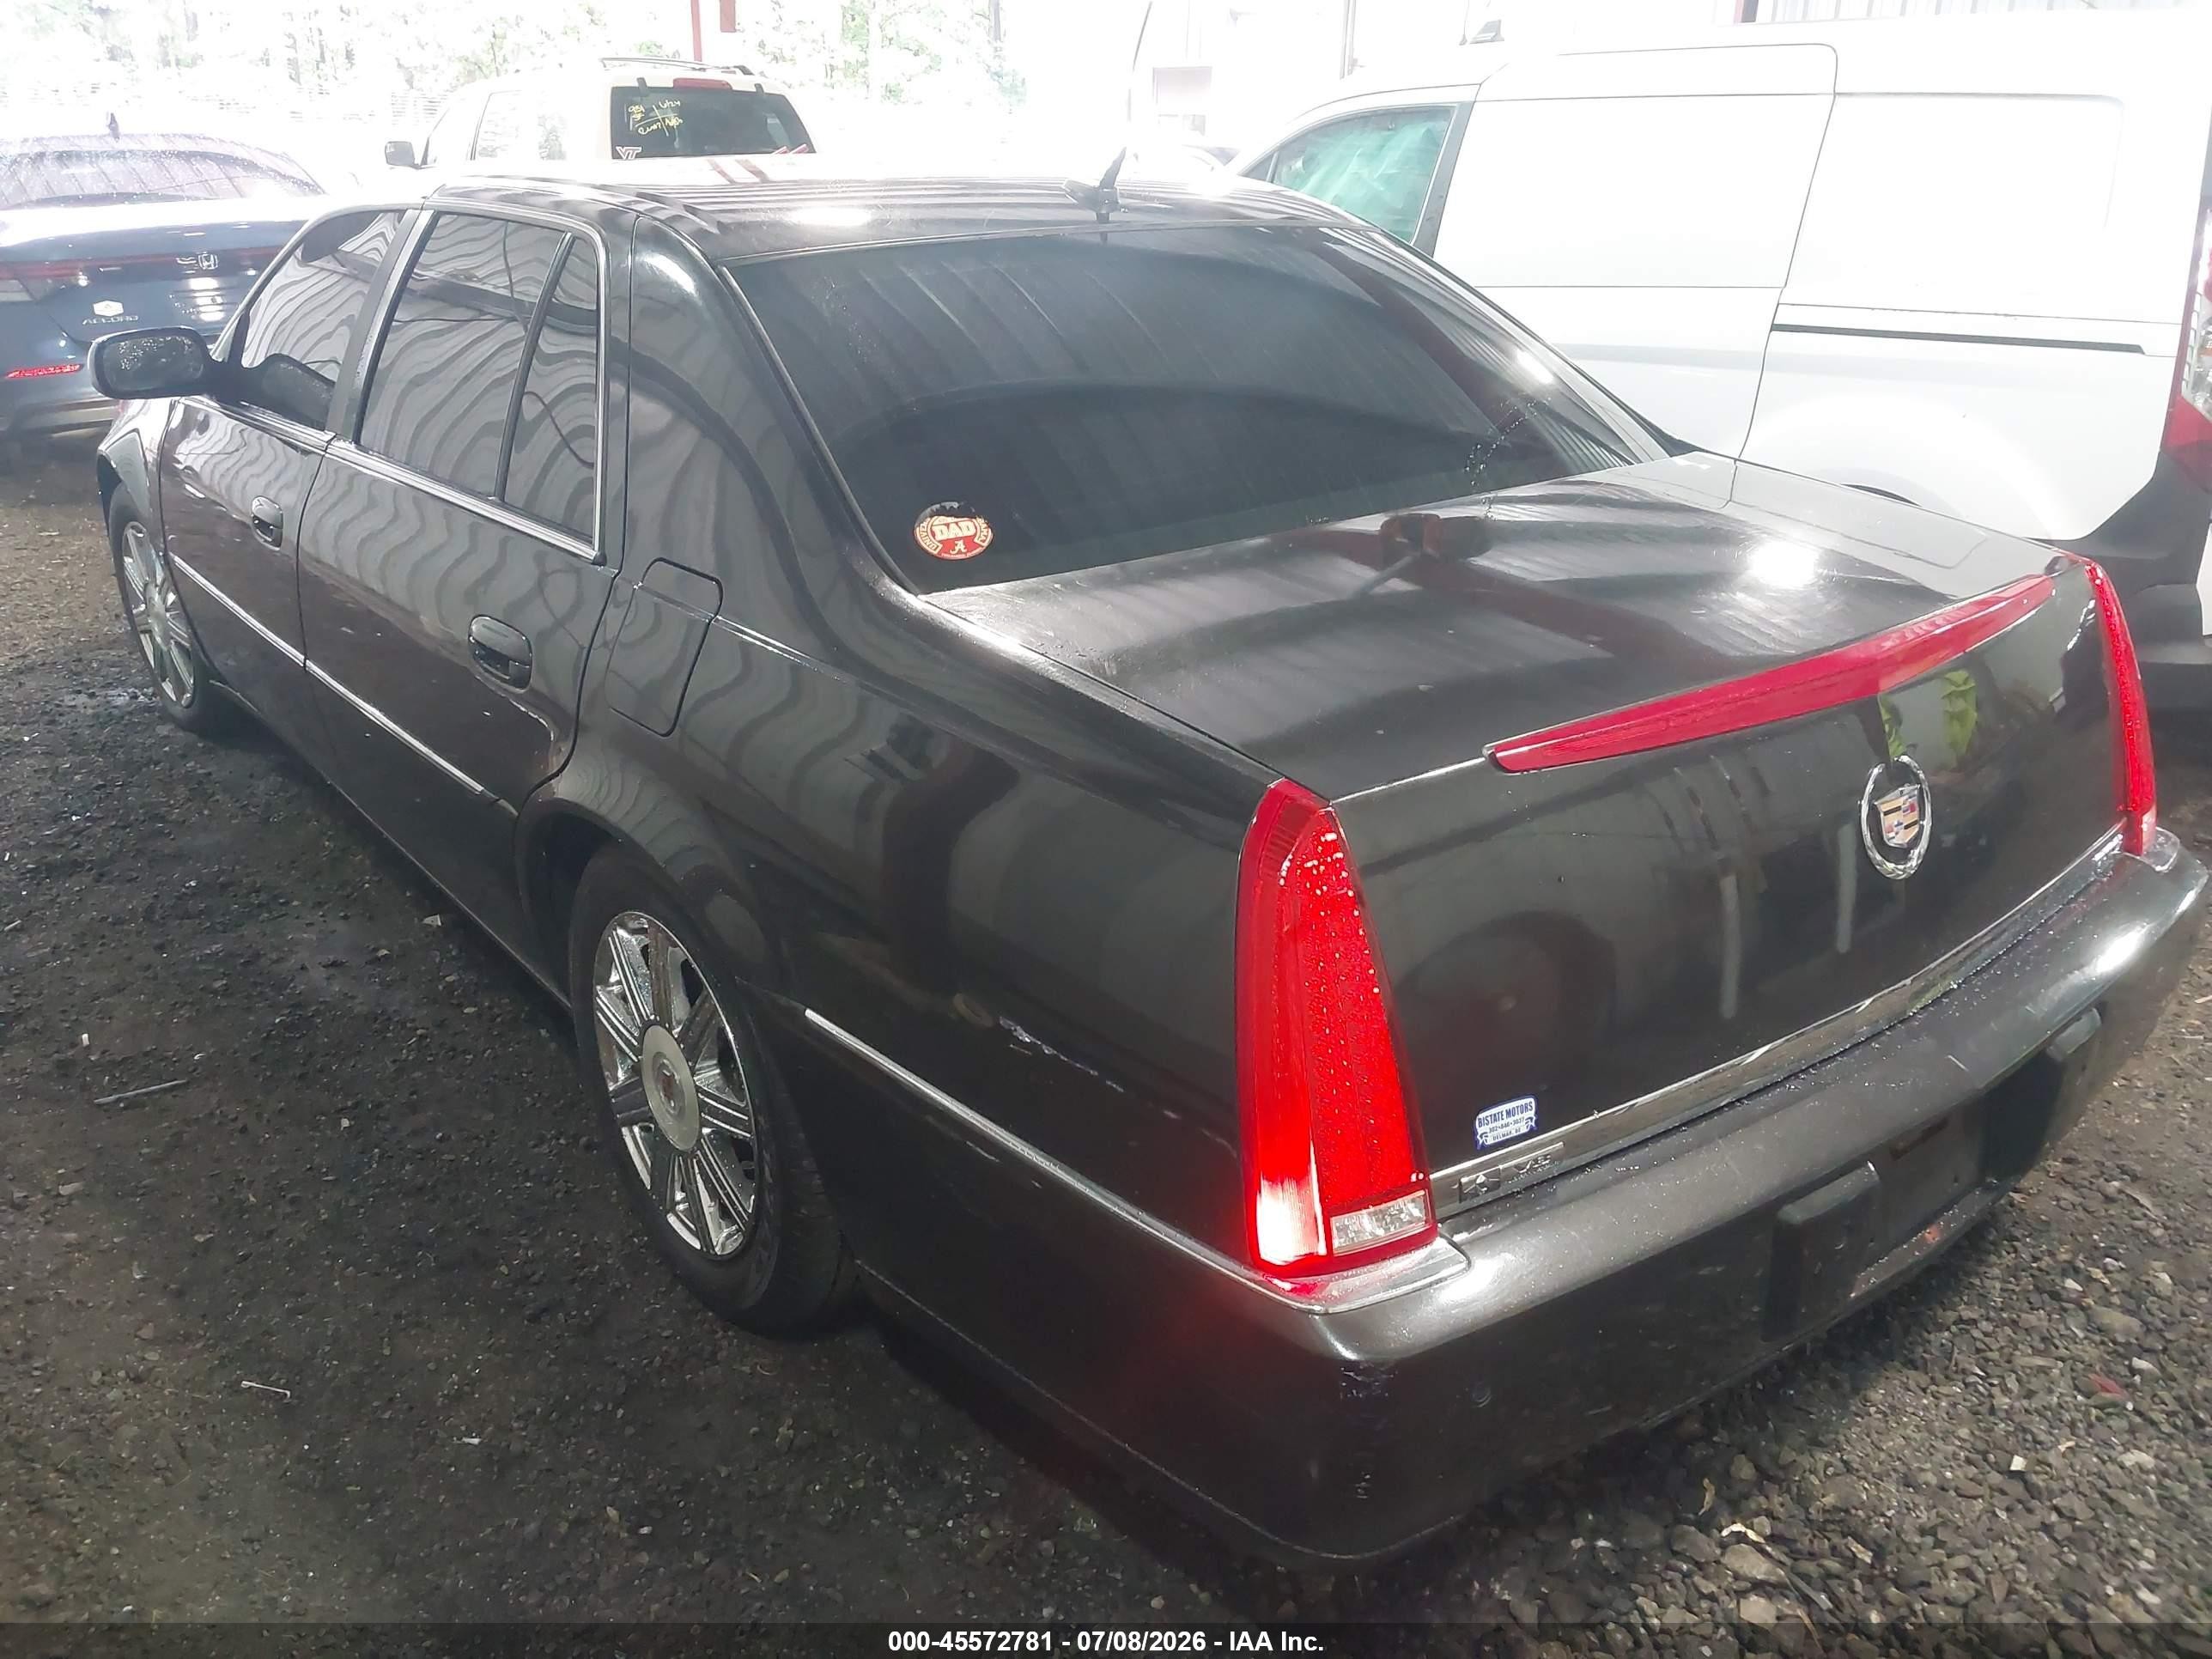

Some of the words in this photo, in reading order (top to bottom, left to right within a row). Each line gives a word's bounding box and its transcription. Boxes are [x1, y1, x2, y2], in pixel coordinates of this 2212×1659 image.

[616, 146, 642, 160] VT
[932, 520, 976, 541] DAD
[1478, 1110, 1504, 1128] BISTATE
[1505, 1101, 1534, 1118] MOTORS
